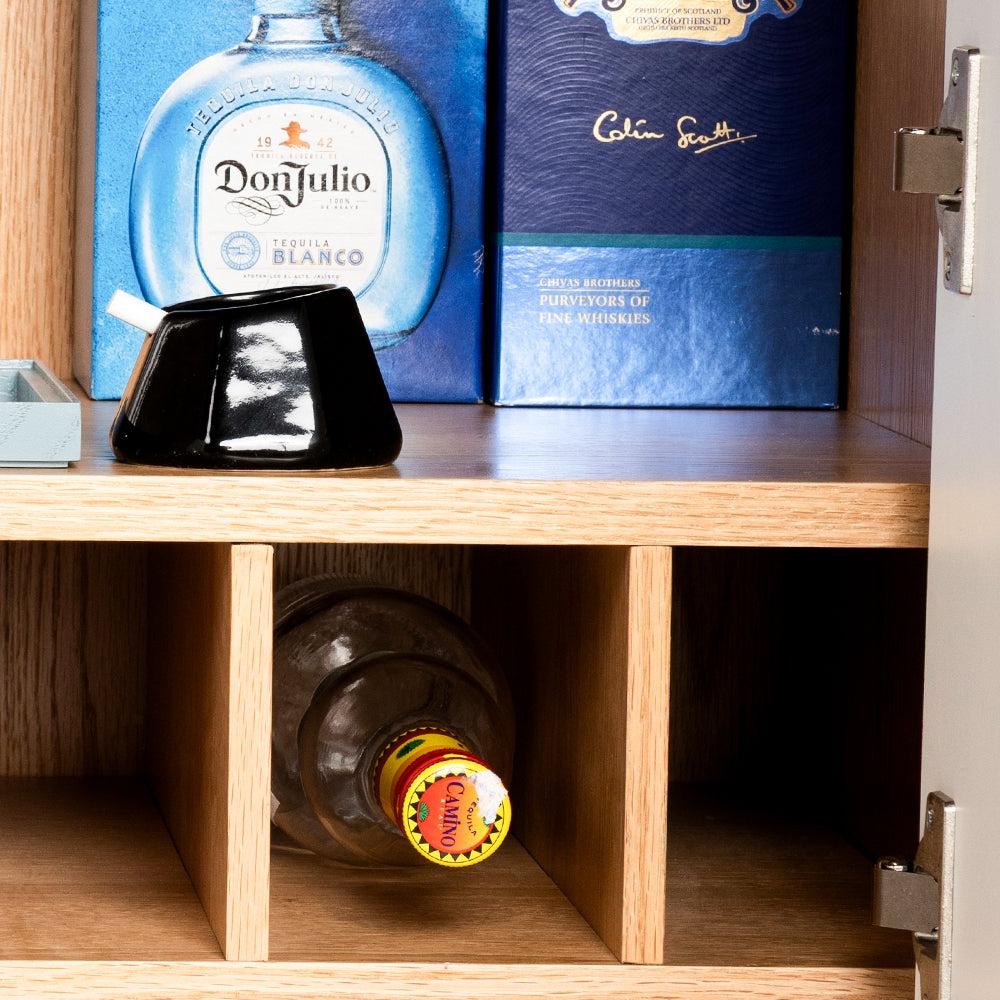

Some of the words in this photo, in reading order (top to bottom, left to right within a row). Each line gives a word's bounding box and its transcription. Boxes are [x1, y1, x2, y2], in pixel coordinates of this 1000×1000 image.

[626, 17, 659, 25] CHIVAS
[661, 17, 711, 25] BROTHERS
[713, 18, 731, 26] LTD
[187, 76, 276, 136] TEQUILA
[289, 75, 335, 92] DON
[341, 83, 400, 136] JULIO
[592, 110, 664, 143] Colin
[257, 136, 272, 148] 19
[317, 137, 333, 149] 42
[273, 239, 330, 248] TEQUILA
[272, 248, 364, 266] BLANCO
[540, 277, 580, 287] CHIVAS
[583, 279, 641, 288] BROTHERS
[540, 294, 625, 308] PURVEYORS
[630, 295, 650, 308] OF
[540, 311, 573, 323] FINE
[578, 312, 651, 324] WHISKIES
[466, 798, 480, 837] EQUILA
